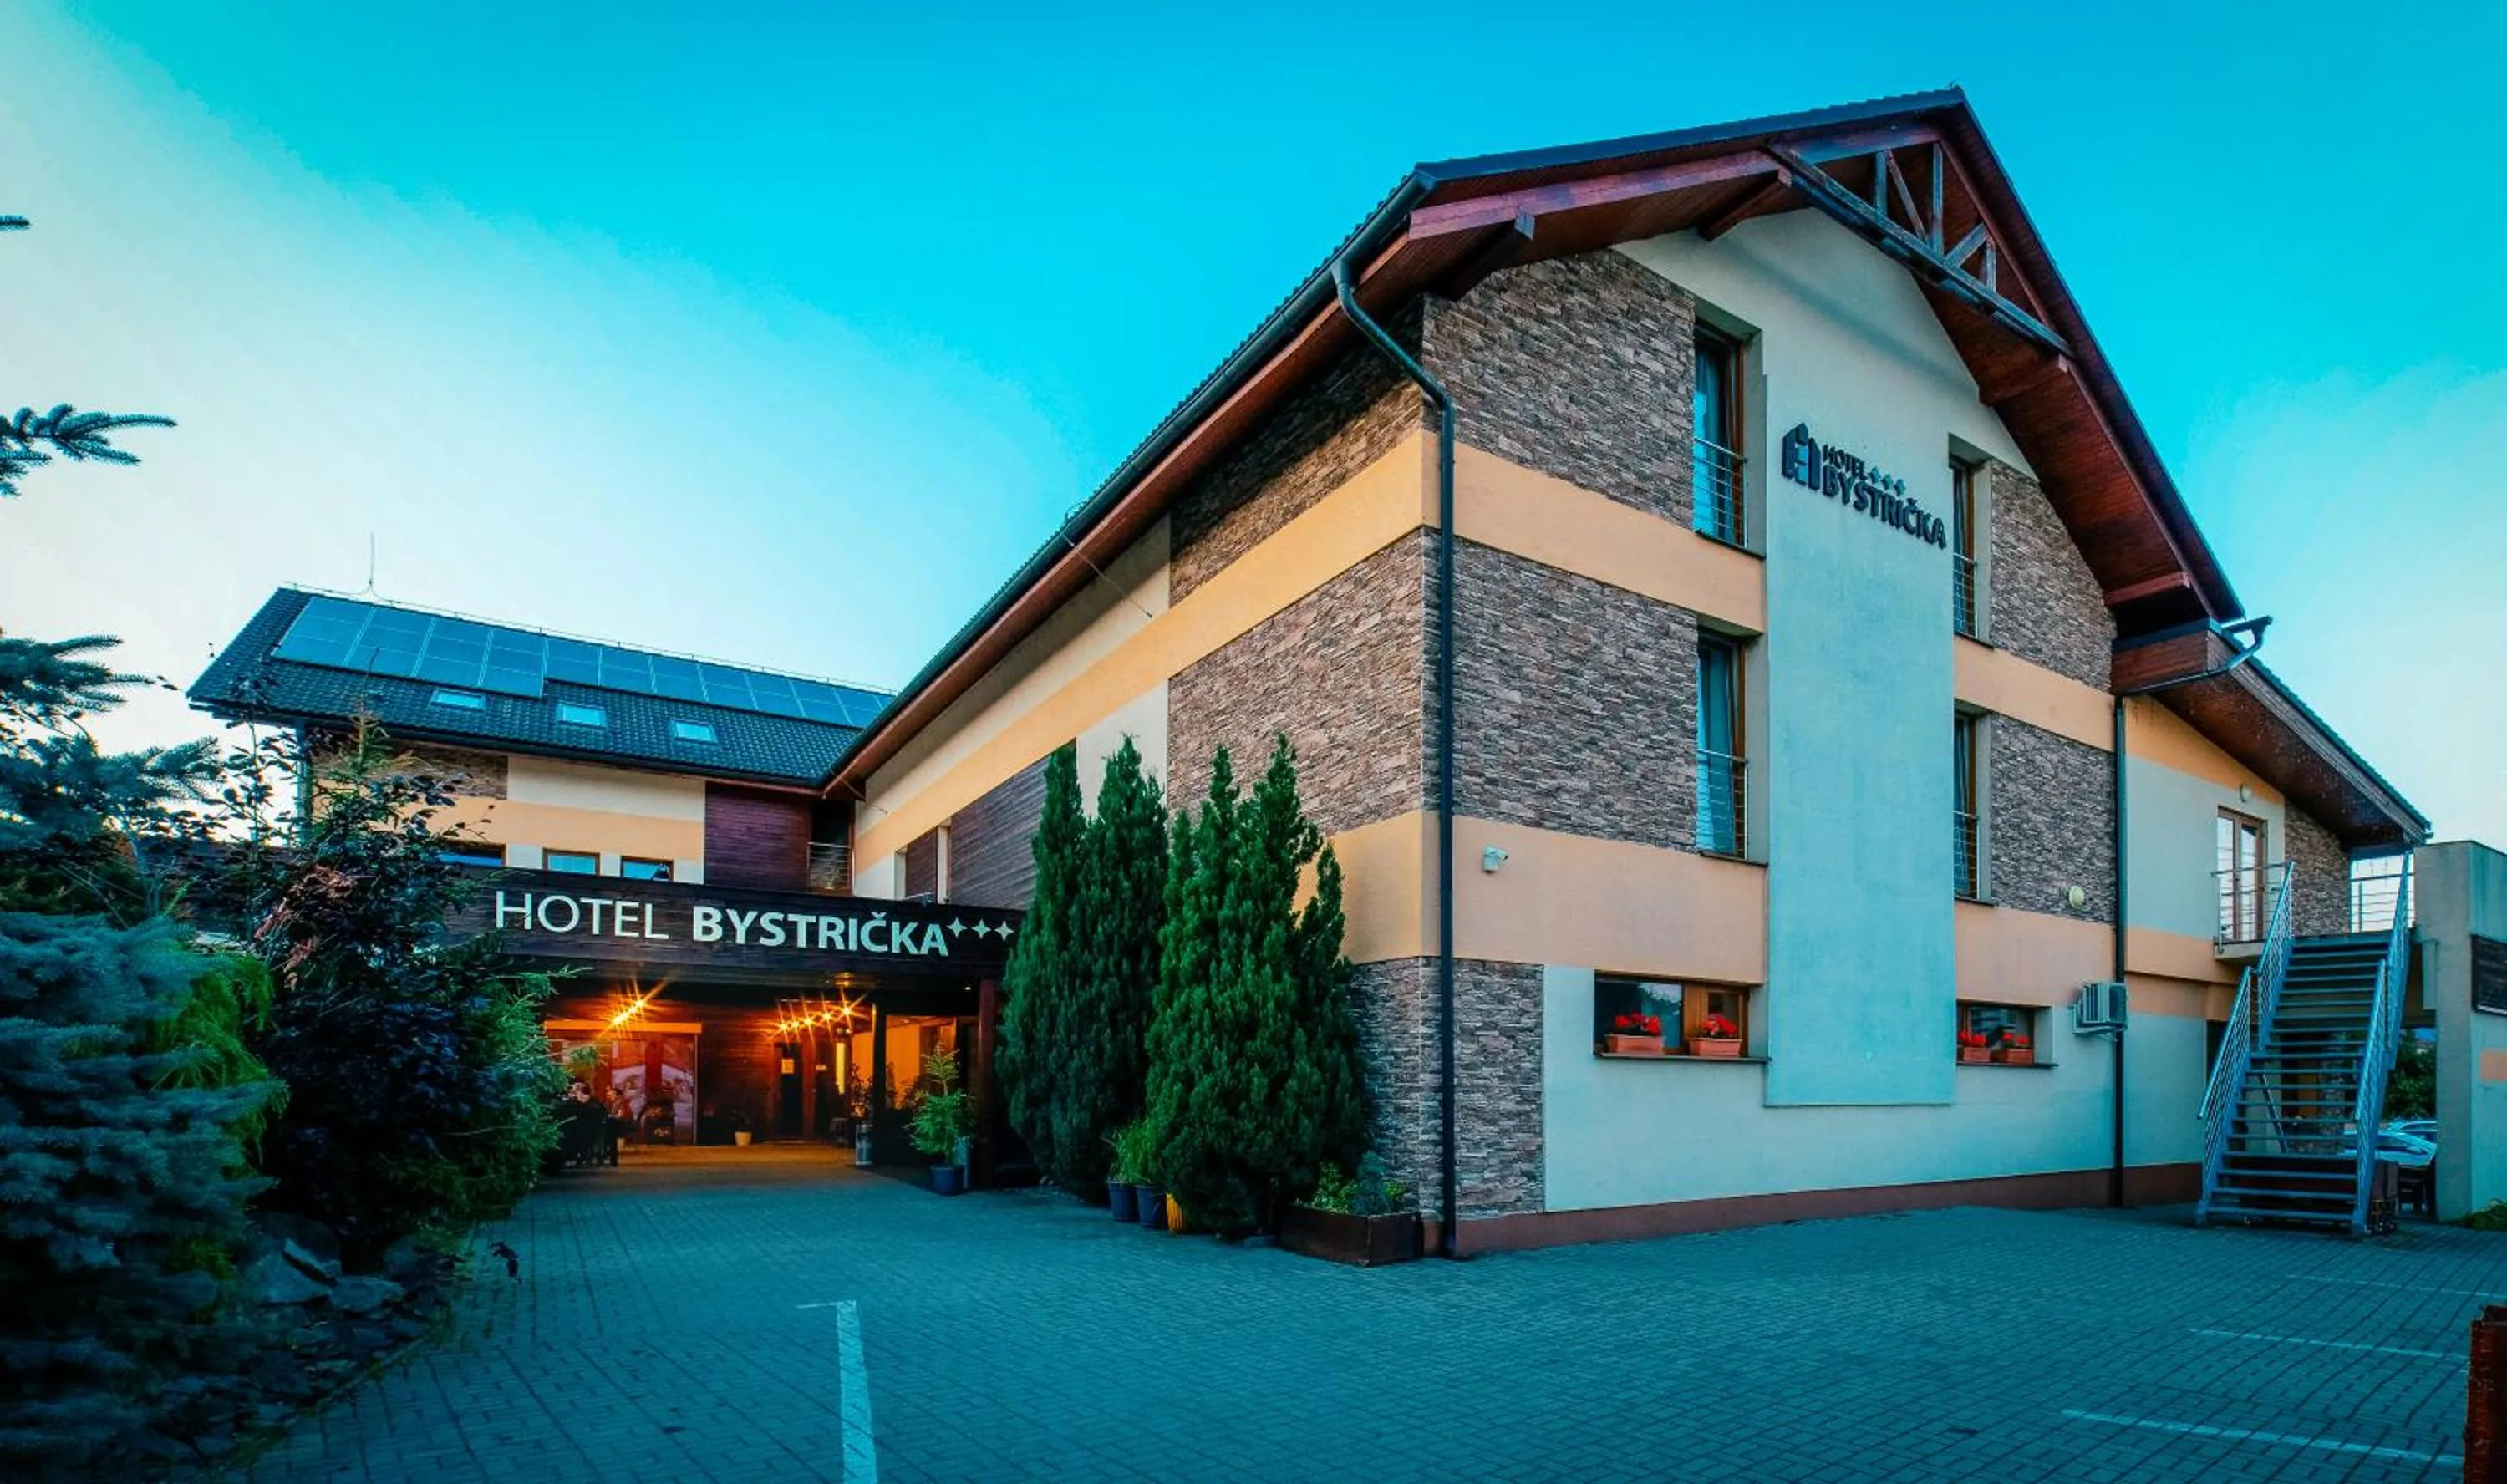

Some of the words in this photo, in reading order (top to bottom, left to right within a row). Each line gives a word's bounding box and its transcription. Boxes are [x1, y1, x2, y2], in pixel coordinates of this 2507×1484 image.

[1823, 444, 1867, 480] HOTEL
[1823, 465, 1947, 550] BYSTRIČKA
[496, 890, 669, 940] HOTEL
[693, 905, 949, 957] BYSTRIČKA
